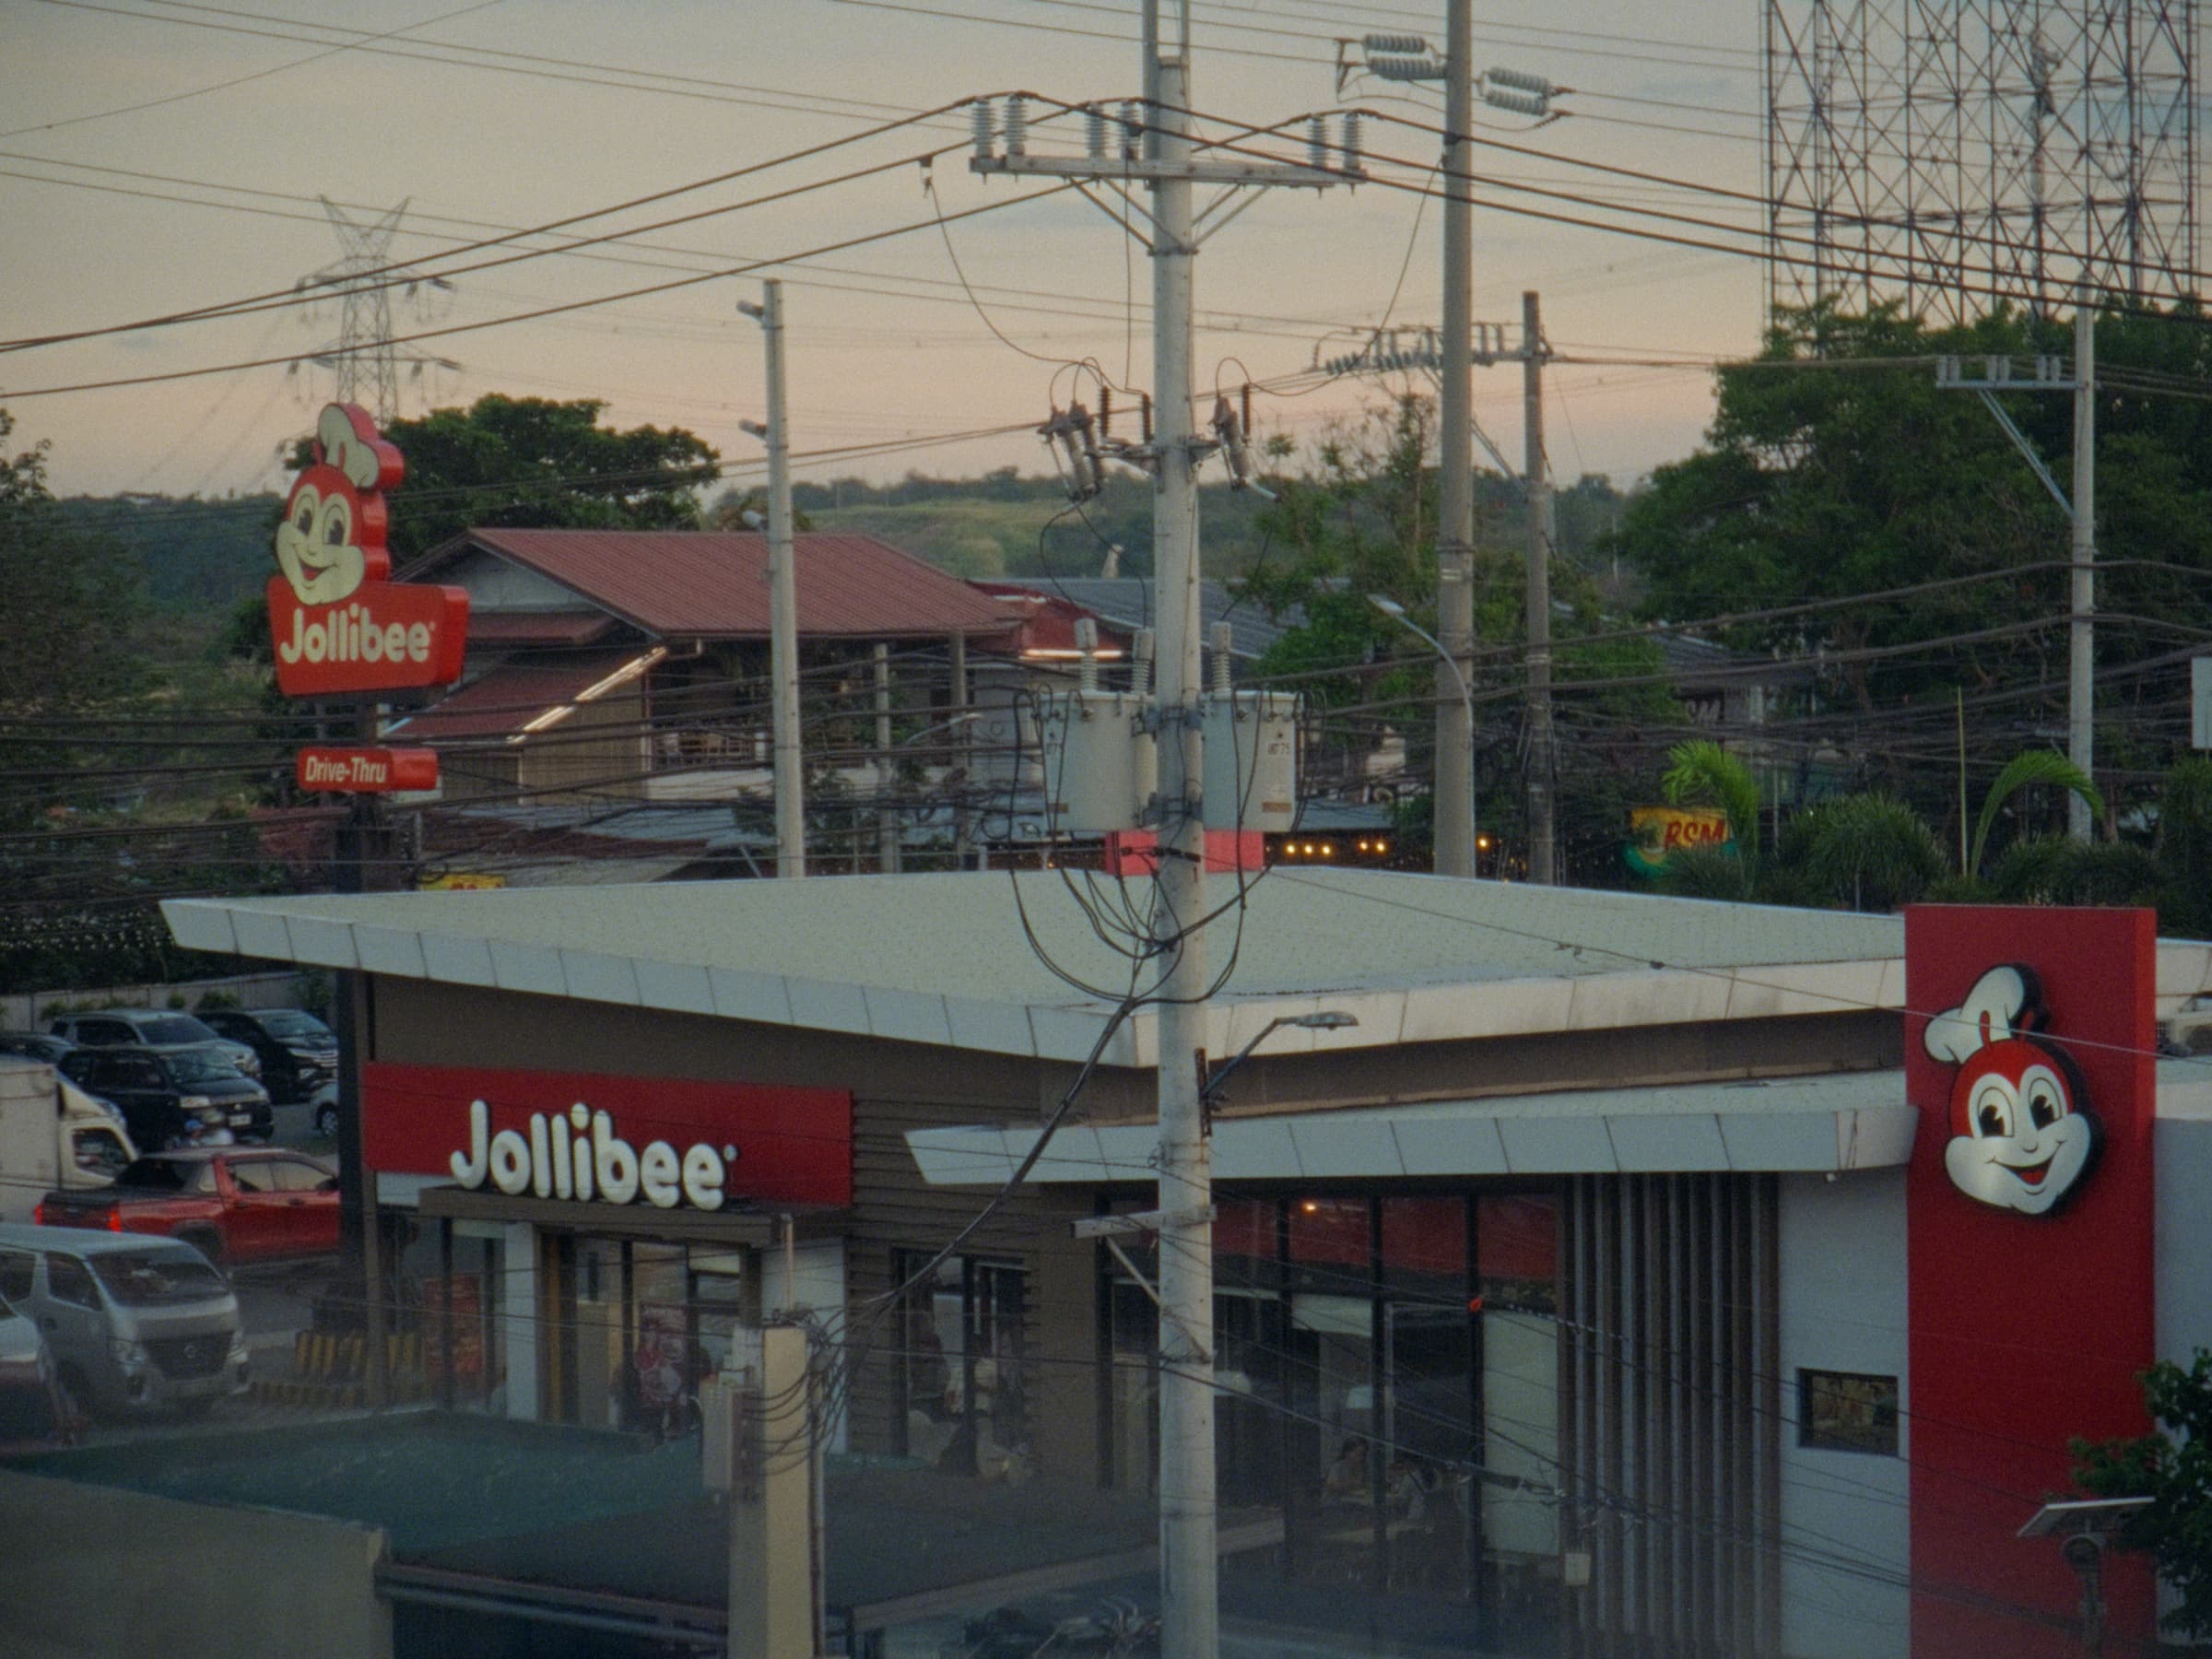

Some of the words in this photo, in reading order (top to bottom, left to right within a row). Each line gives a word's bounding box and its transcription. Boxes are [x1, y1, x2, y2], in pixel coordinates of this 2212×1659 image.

[279, 602, 430, 664] Jollibee
[305, 755, 387, 782] Drive-Thru
[450, 1100, 724, 1211] Jollibee
